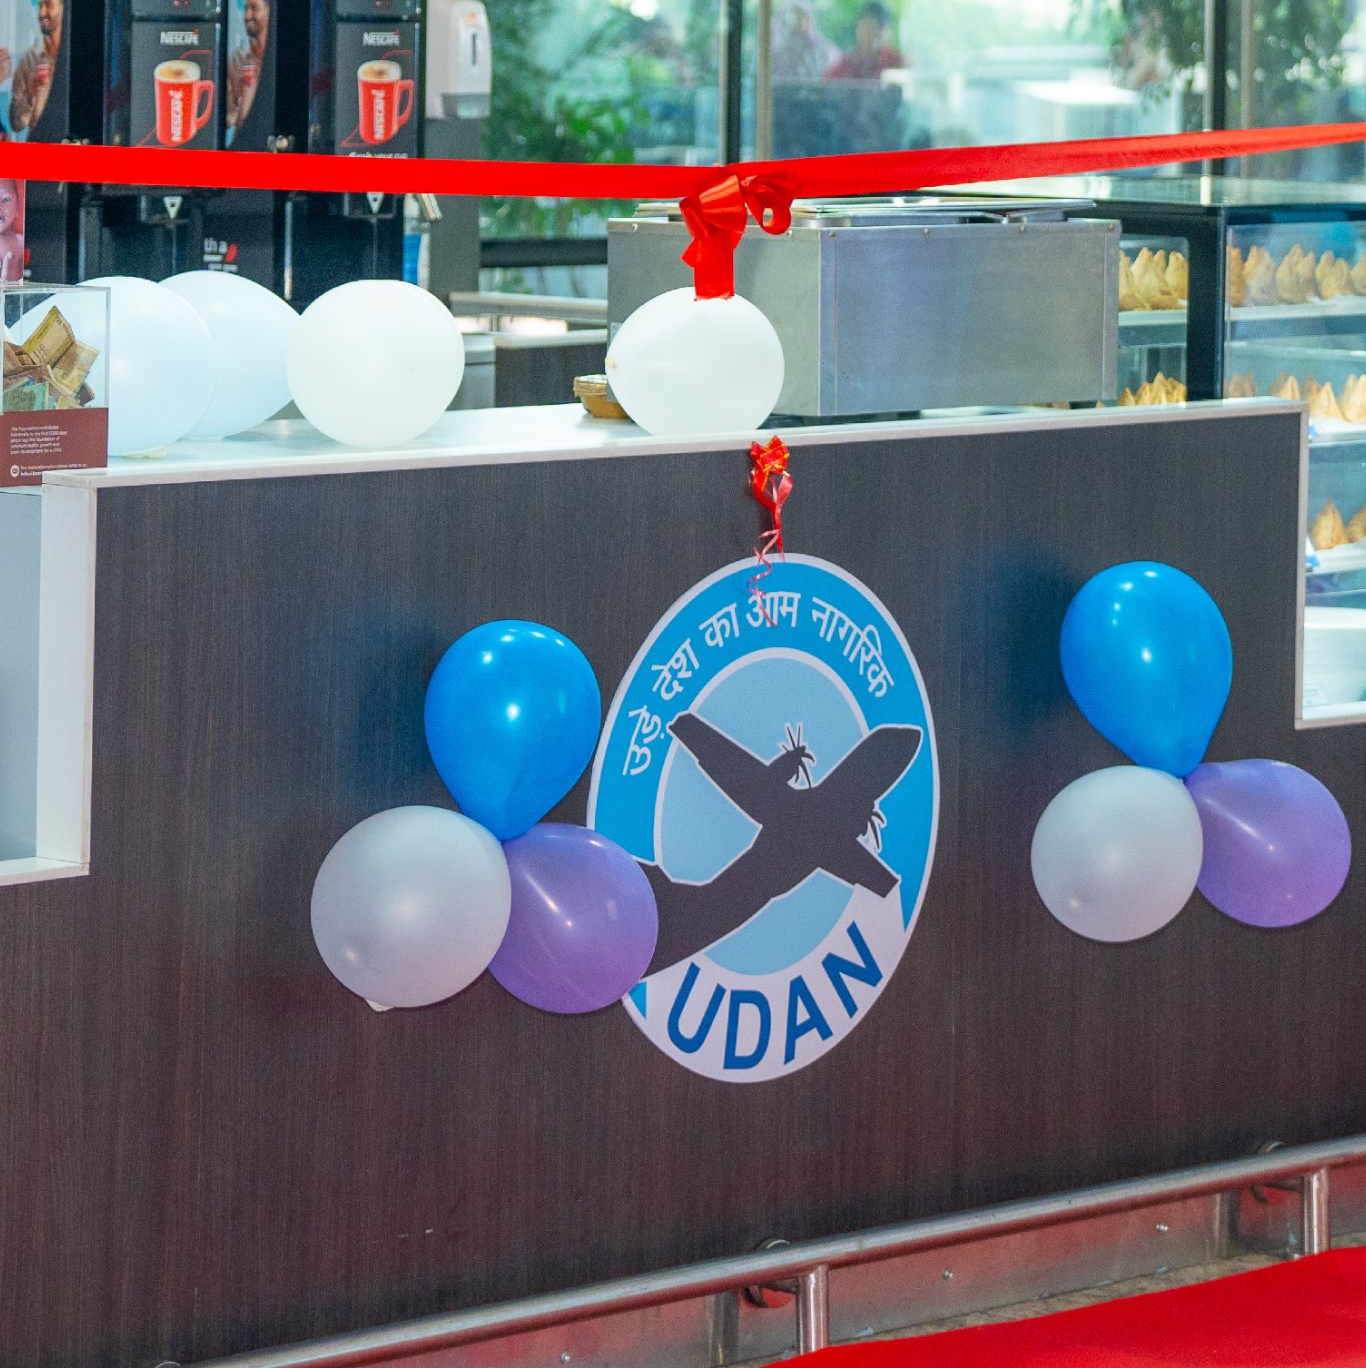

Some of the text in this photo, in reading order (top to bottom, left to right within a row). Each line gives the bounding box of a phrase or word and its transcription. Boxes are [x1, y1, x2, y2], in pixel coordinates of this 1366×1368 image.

[651, 637, 702, 701] देश
[699, 602, 742, 650] का
[745, 590, 802, 629] आम
[810, 595, 895, 700] नागरिक
[667, 920, 885, 1071] UDAN
